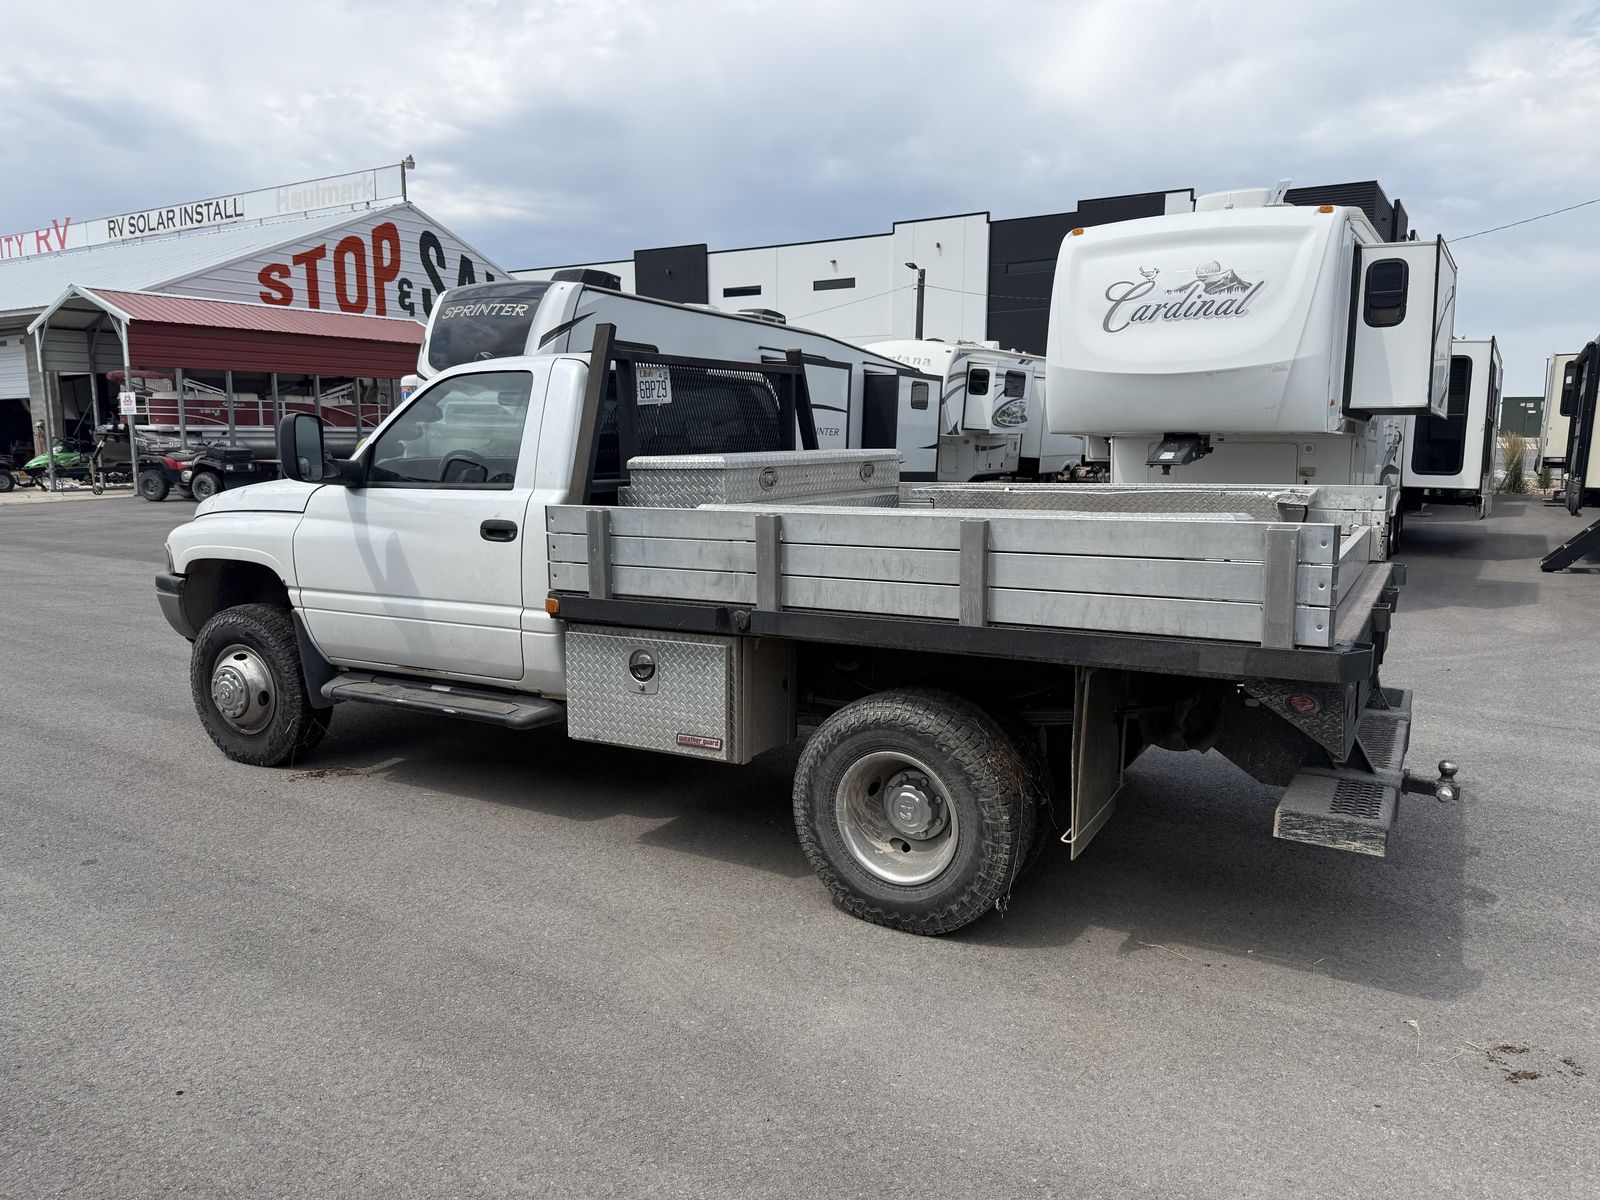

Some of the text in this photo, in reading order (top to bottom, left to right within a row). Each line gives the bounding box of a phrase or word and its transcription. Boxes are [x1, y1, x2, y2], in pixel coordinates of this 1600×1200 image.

[35, 217, 71, 253] RV
[107, 198, 244, 238] RV SOLAR INSTALL
[257, 221, 401, 316] STOP
[398, 277, 416, 317] &
[442, 303, 529, 319] SPRINTER
[1102, 280, 1265, 333] Cardinal
[889, 355, 931, 366] tana
